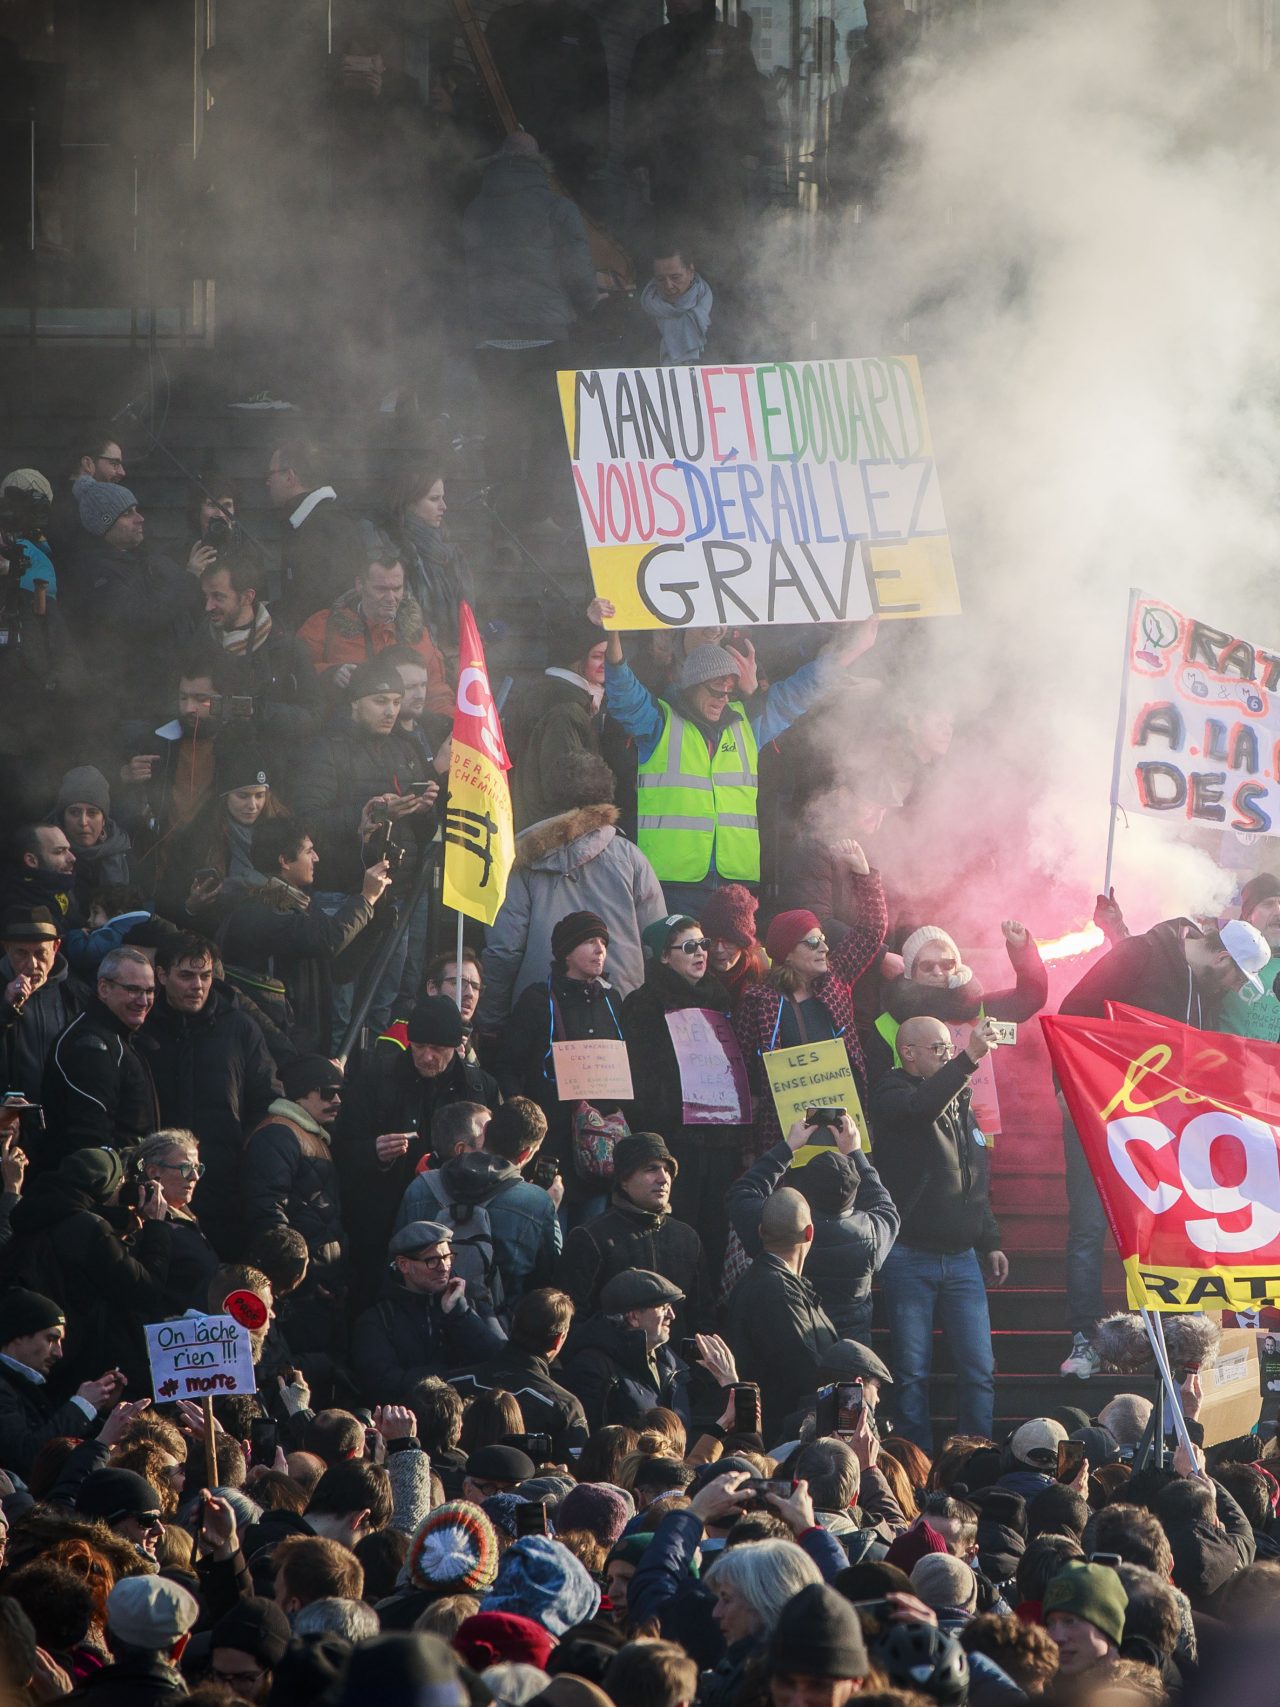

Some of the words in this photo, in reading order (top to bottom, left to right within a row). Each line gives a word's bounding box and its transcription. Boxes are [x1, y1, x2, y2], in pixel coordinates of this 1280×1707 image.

[574, 366, 705, 461] MANU
[701, 366, 758, 461] ET
[755, 357, 925, 465] EDOUARD
[573, 461, 686, 543] VOUS
[637, 539, 920, 626] GRAVE
[788, 1051, 820, 1067] LES
[773, 1067, 852, 1093] ENSEIGNANTS
[793, 1093, 845, 1113] RESTENT
[158, 1327, 185, 1347] On
[193, 1320, 239, 1342] lâche
[174, 1348, 214, 1368] rien
